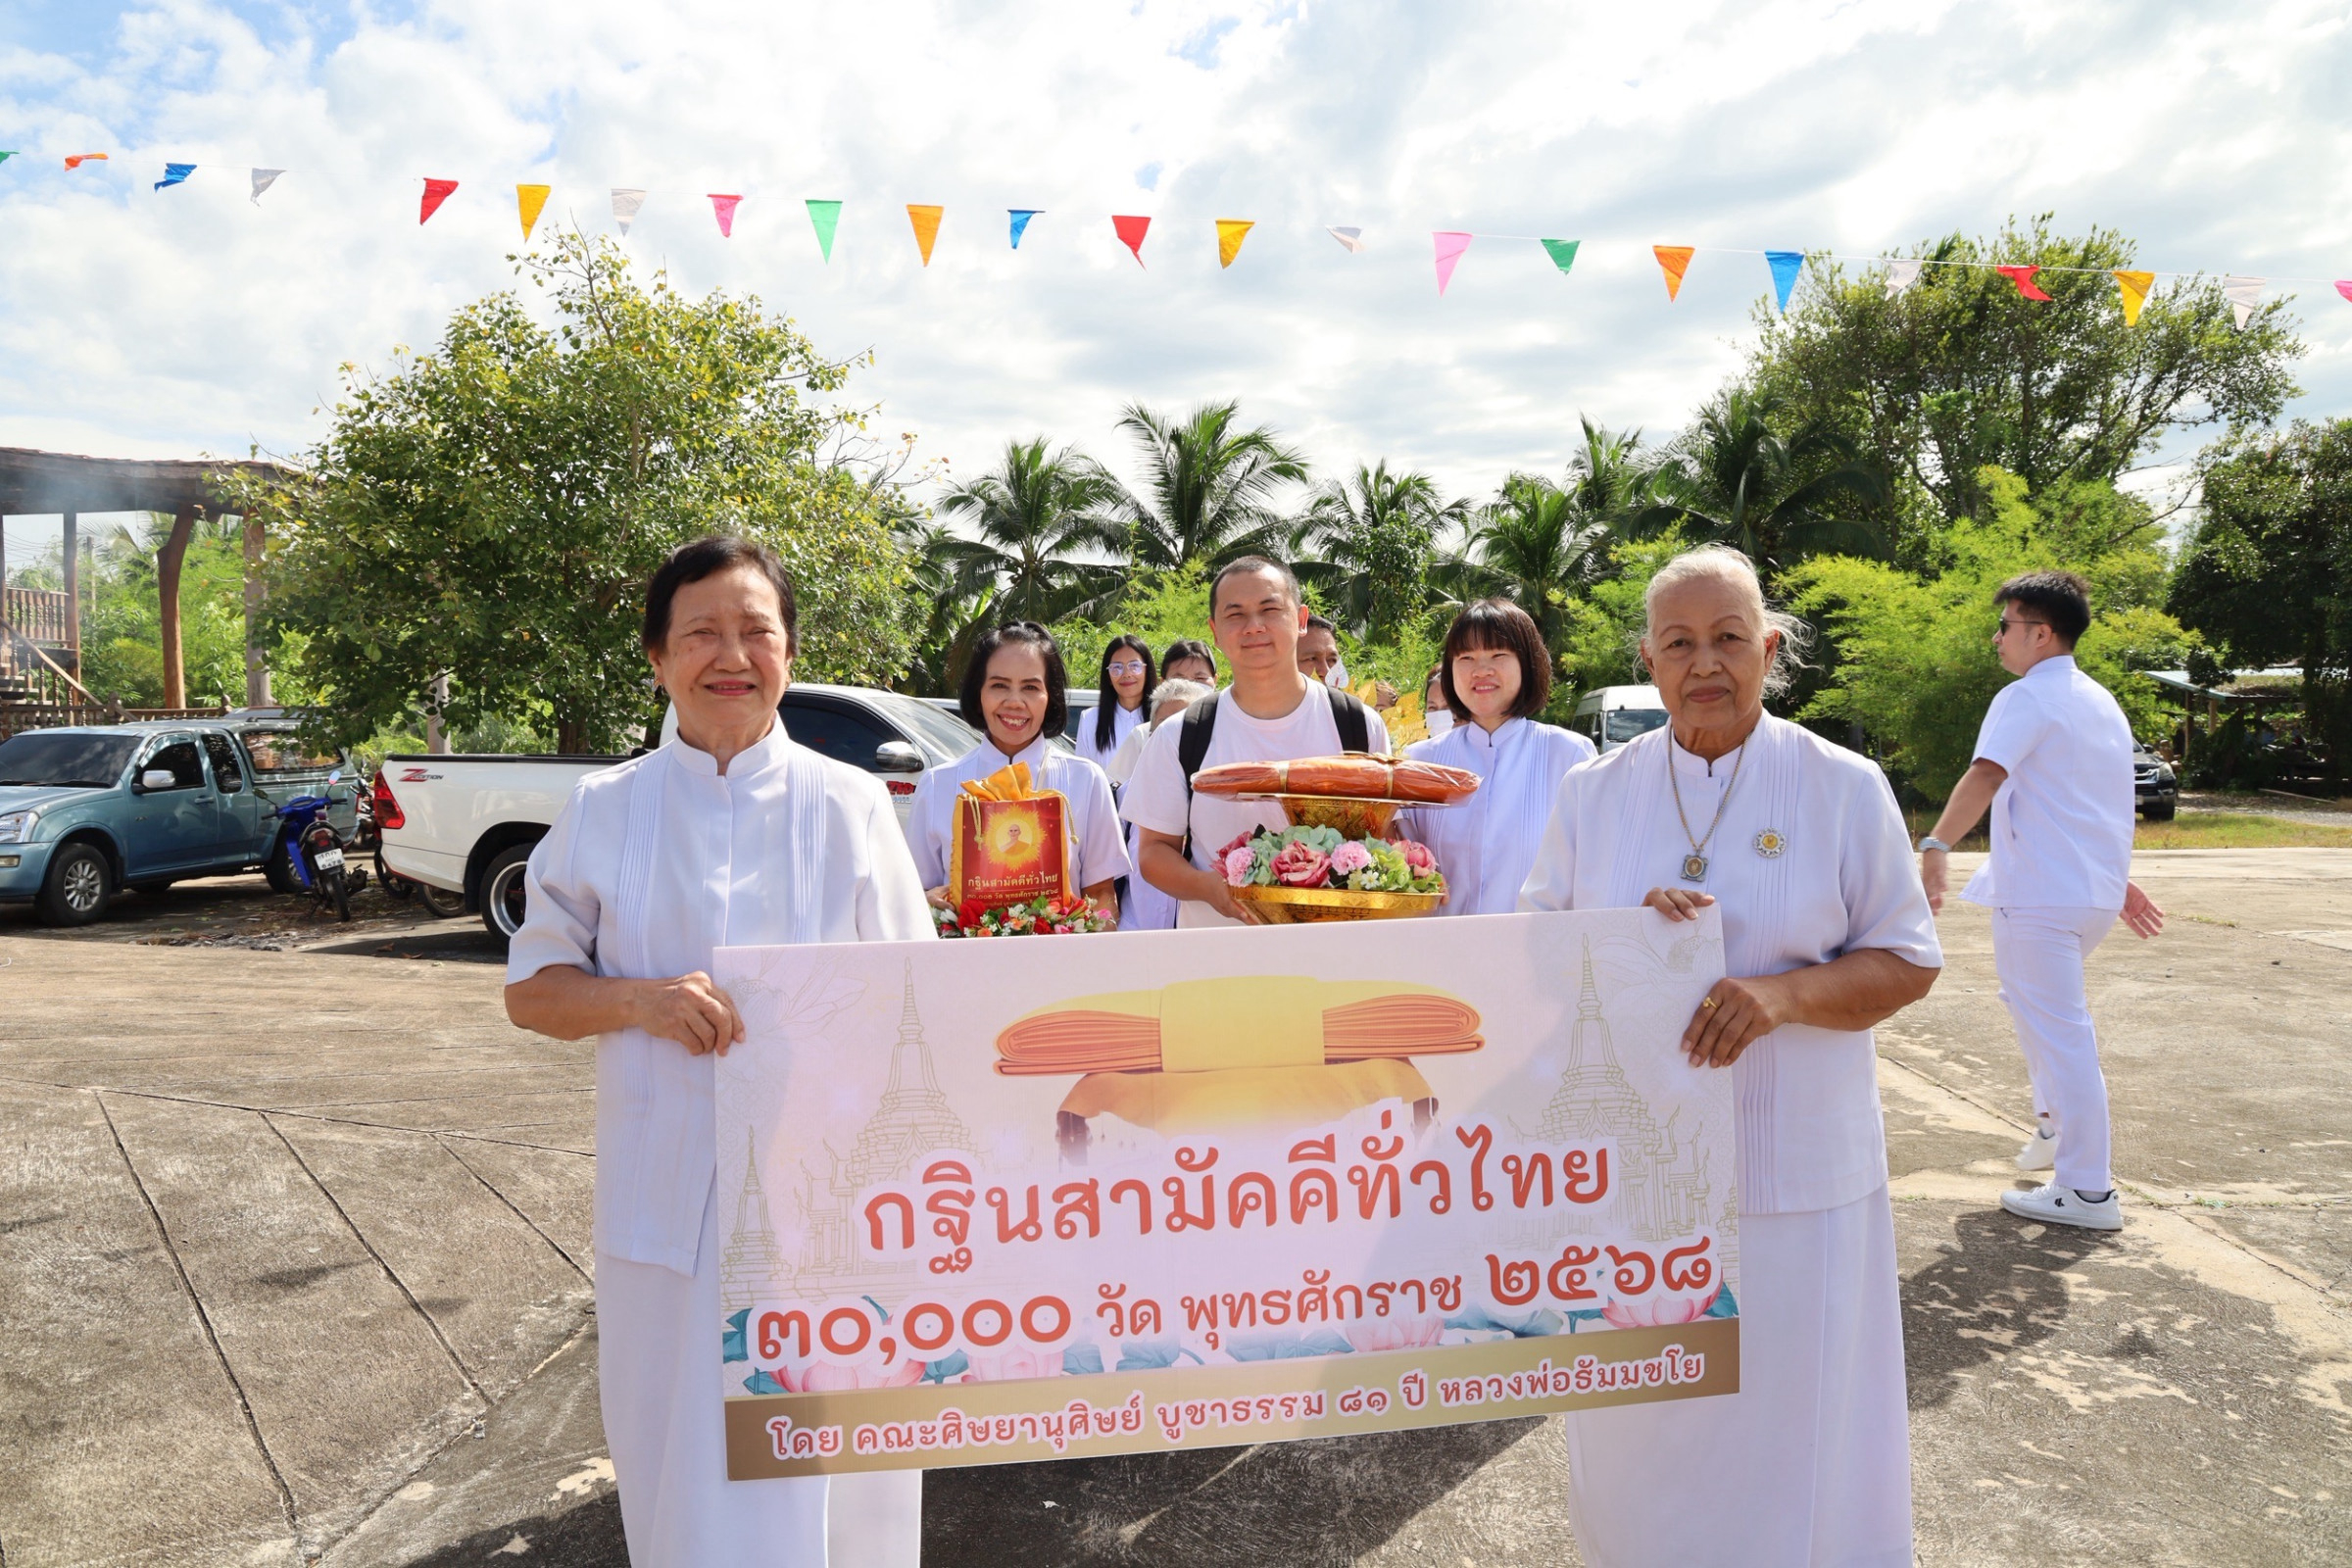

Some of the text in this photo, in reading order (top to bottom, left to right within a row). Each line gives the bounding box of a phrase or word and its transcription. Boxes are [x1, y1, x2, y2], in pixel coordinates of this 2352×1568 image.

[863, 1108, 1609, 1273] กฐินสามัคคีทั่วไทย
[757, 1235, 1714, 1366] ๓๐,๐๐๐ วัด พุทธศักราช ๒๕๖๘
[770, 1348, 1702, 1454] โดย คณะศิษยานุศิษย์ บูชาธรรม ๘๑ ปี หลวงพ่อธัมมชโย
